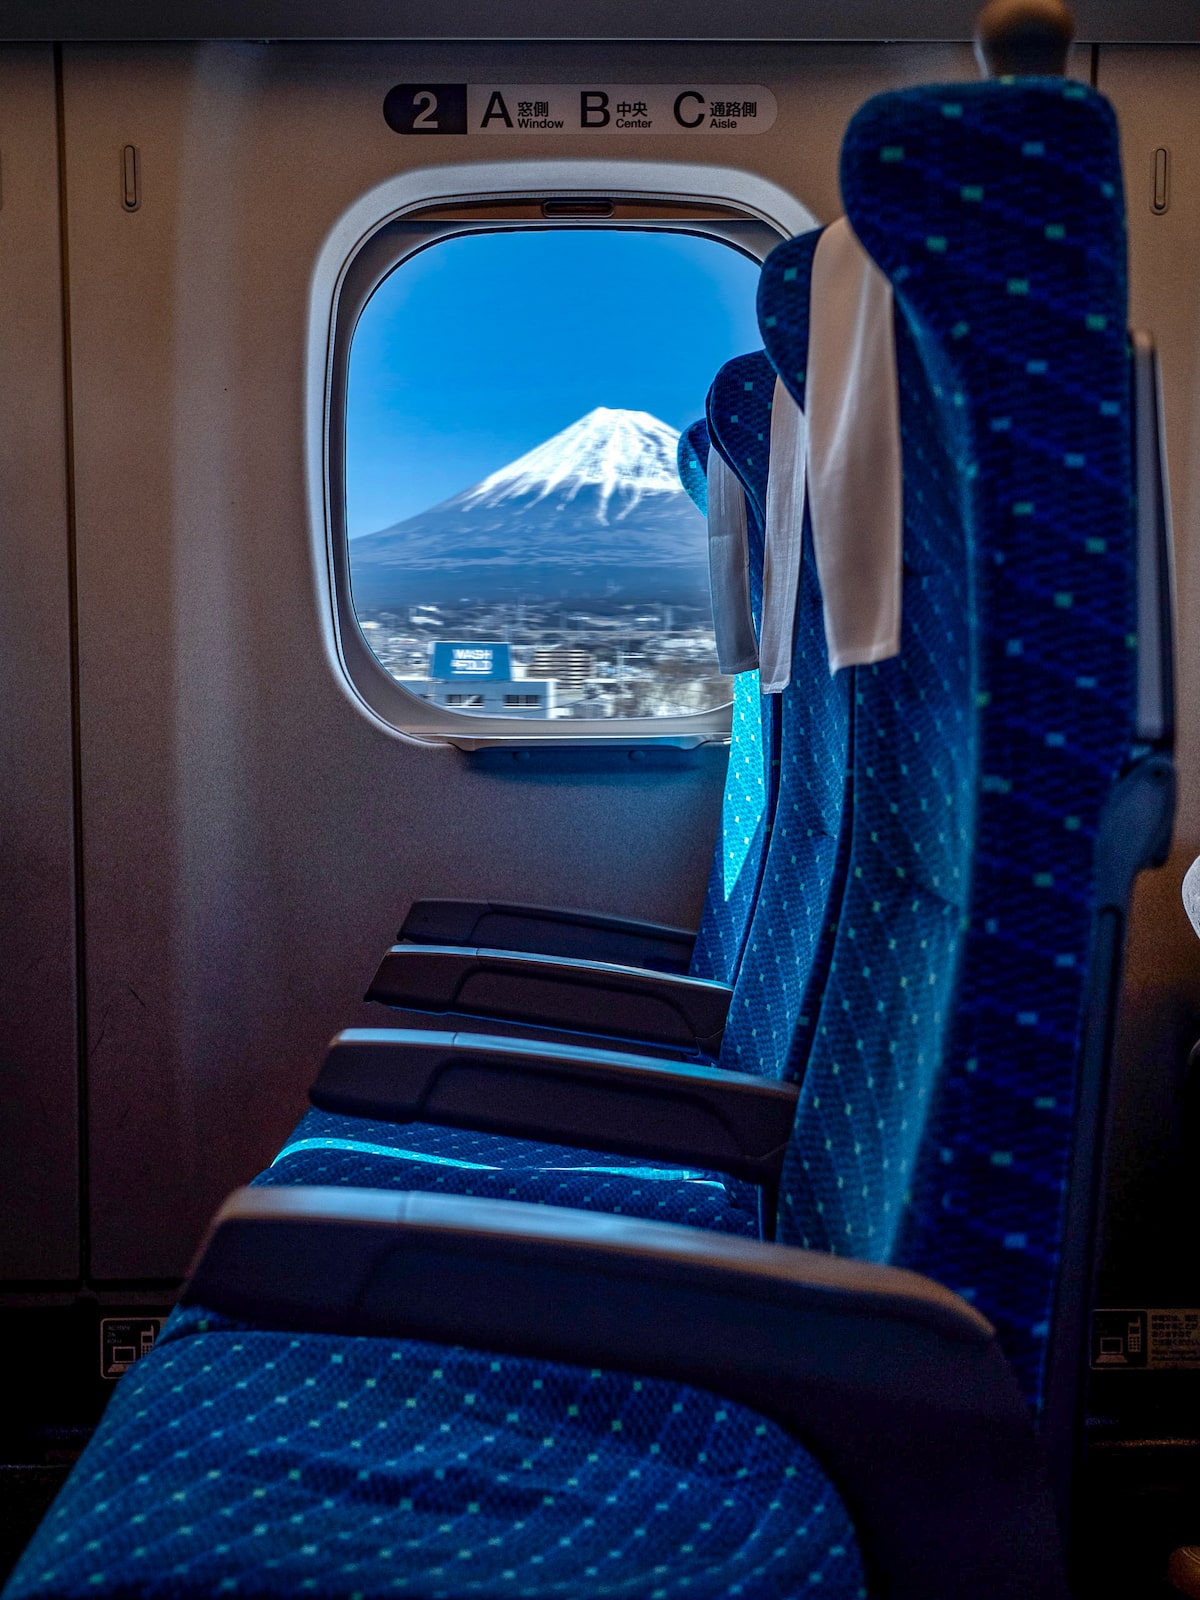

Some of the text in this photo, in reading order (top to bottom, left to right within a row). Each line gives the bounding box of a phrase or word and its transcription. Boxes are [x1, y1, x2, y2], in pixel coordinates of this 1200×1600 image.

[413, 91, 438, 128] 2
[480, 91, 513, 128] A
[517, 101, 549, 117] 窓側
[580, 91, 610, 128] B
[616, 101, 648, 117] 中央
[673, 91, 705, 128] C
[709, 101, 757, 117] 通路側
[517, 118, 564, 128] Window
[616, 118, 652, 128] Center
[709, 118, 737, 129] Aisle
[452, 649, 493, 660] WASH
